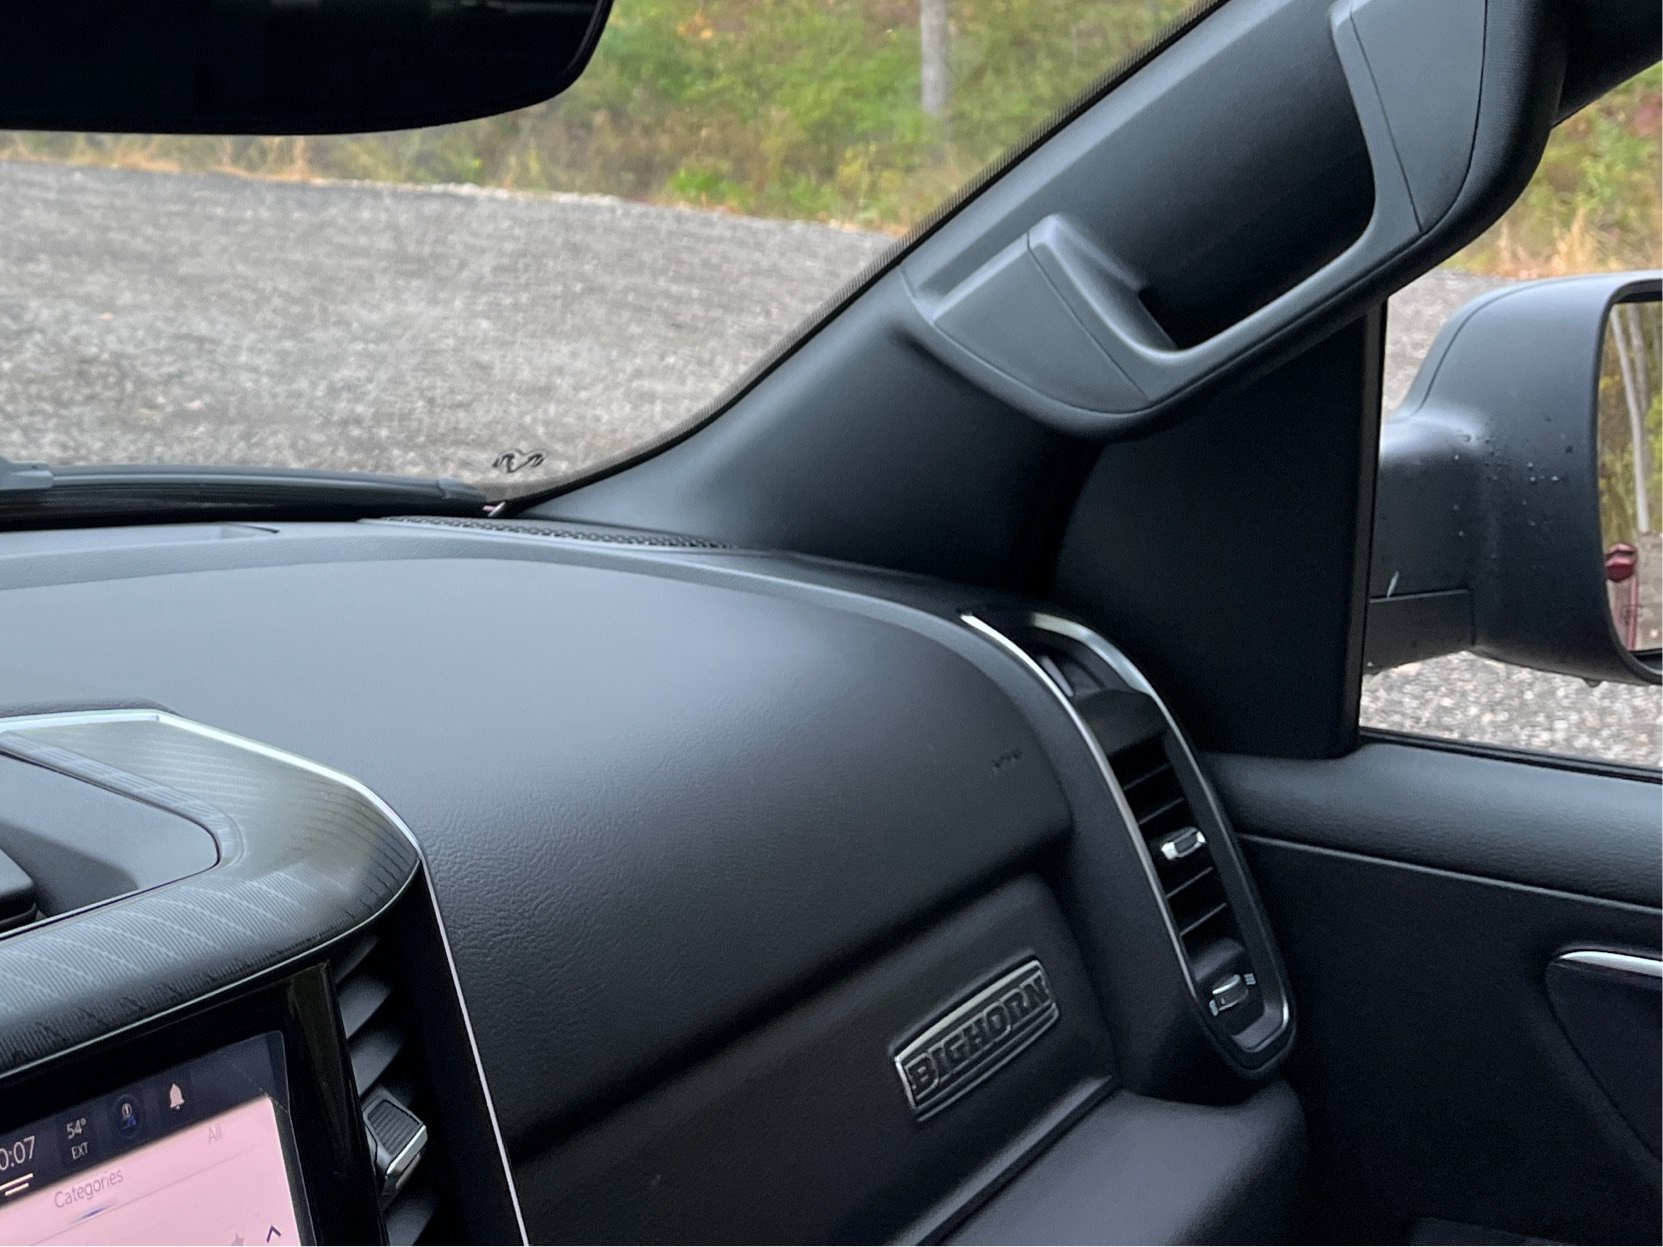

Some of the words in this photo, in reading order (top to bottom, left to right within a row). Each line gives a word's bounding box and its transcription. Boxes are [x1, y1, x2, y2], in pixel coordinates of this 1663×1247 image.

[904, 969, 1053, 1100] BIGHORN
[207, 1124, 222, 1144] All
[71, 1141, 88, 1161] EXT
[53, 1168, 124, 1209] Categories
